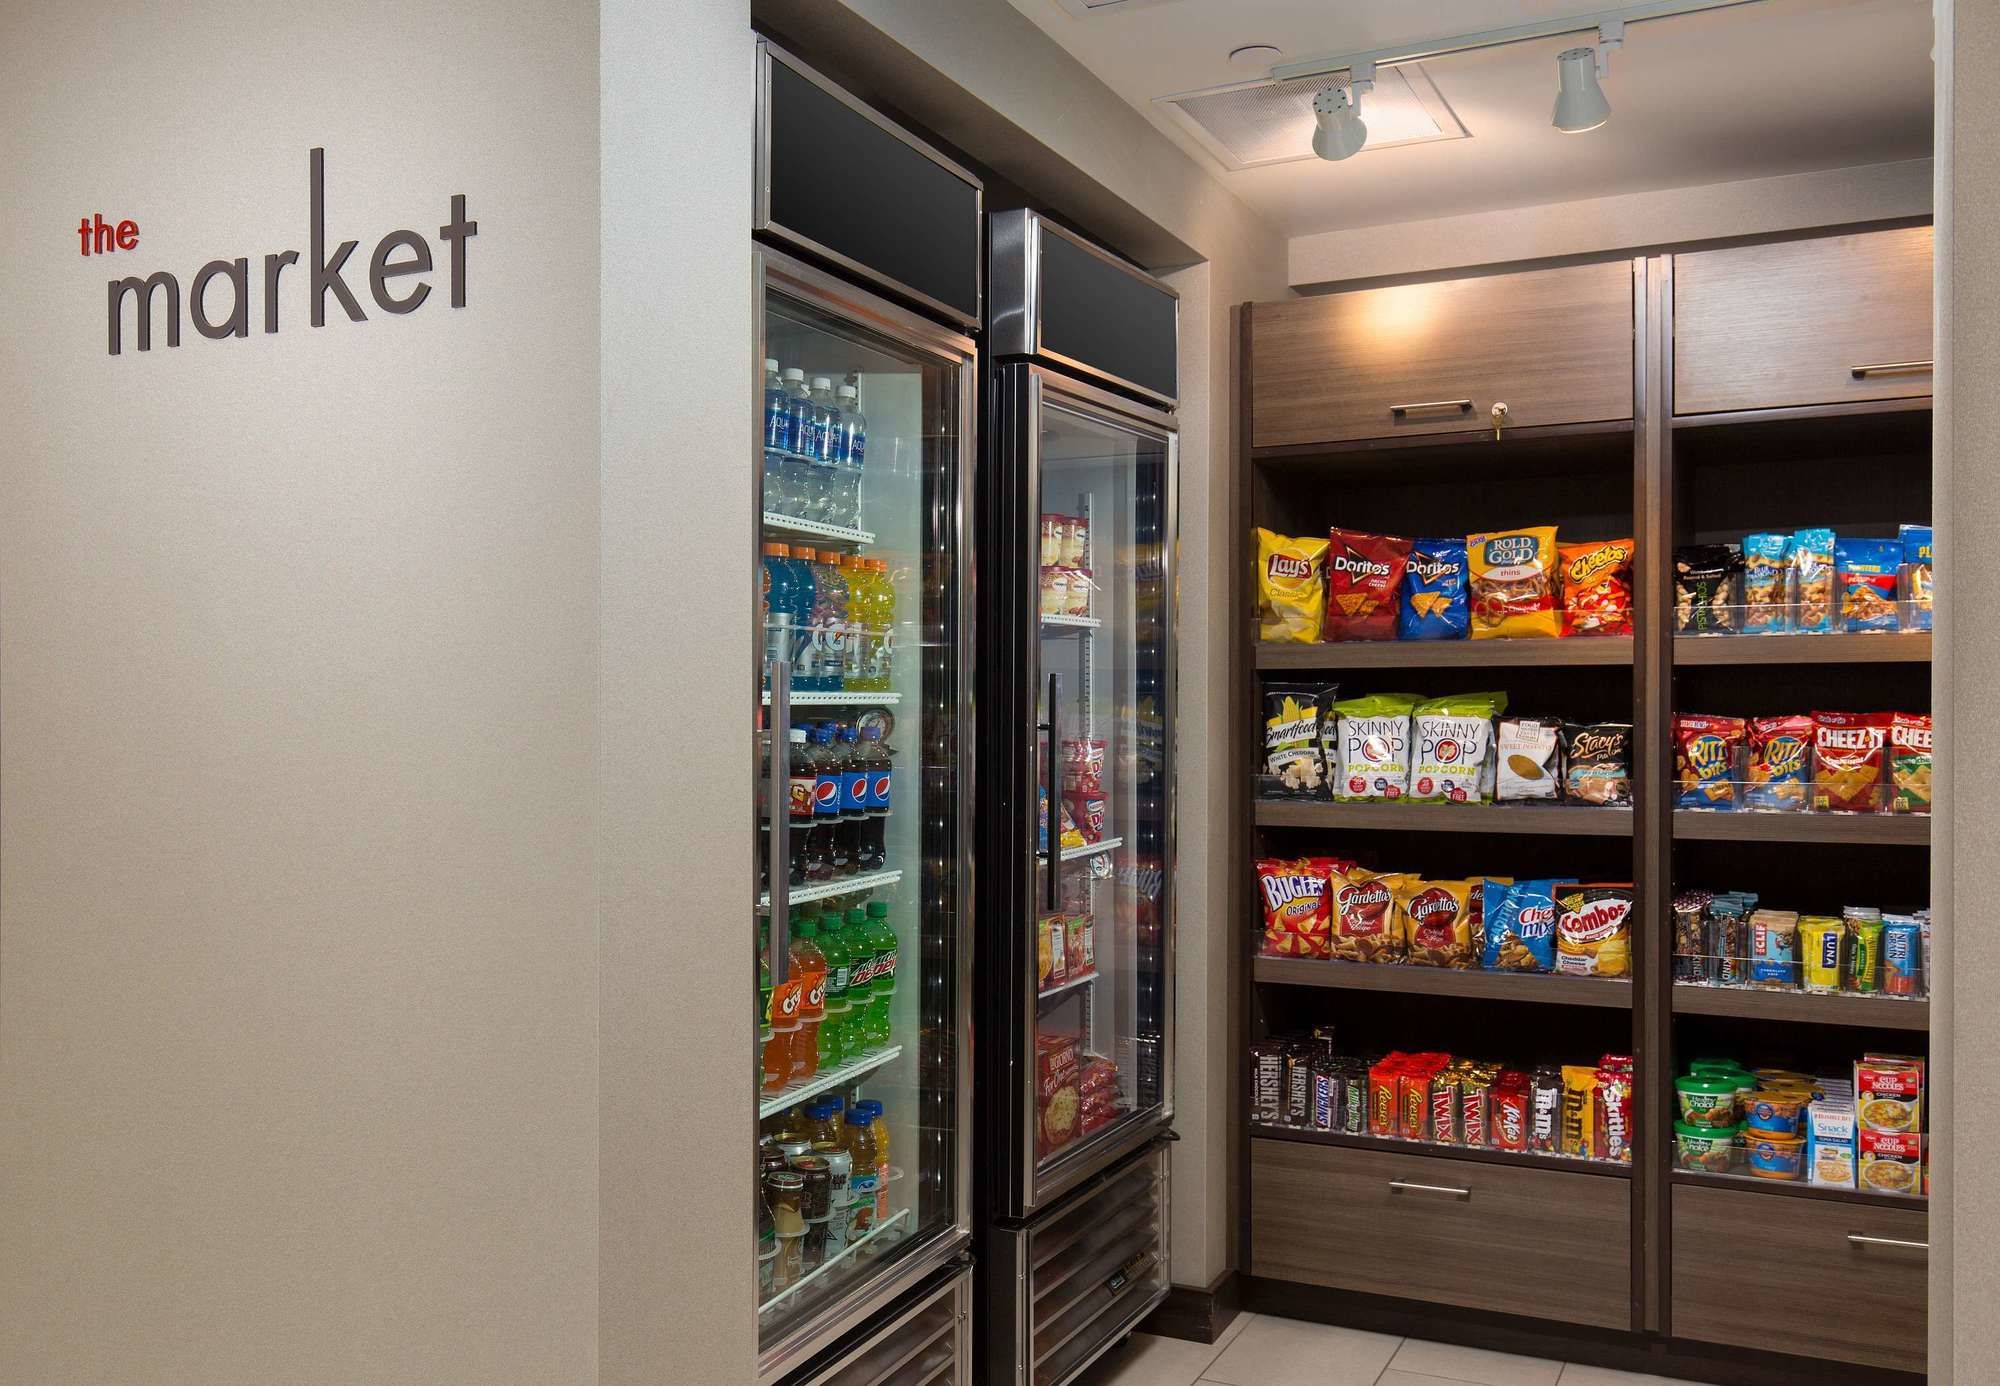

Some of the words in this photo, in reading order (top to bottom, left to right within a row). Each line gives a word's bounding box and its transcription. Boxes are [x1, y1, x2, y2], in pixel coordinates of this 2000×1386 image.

[77, 213, 140, 257] the
[107, 147, 478, 356] market
[1494, 537, 1532, 549] ROLD
[1335, 556, 1390, 576] Doritos
[1406, 561, 1459, 575] Doritos
[1488, 549, 1534, 565] GOLD
[1570, 545, 1626, 582] Cheetos
[1500, 568, 1521, 577] thins
[1348, 720, 1403, 736] SKINNY
[1421, 721, 1480, 738] SKINNY
[1421, 738, 1477, 765] POP
[1571, 733, 1624, 759] Stacy's
[1689, 740, 1728, 767] RITZ
[1764, 740, 1802, 765] RITZ
[1418, 765, 1476, 775] POPCORN
[1262, 875, 1326, 912] BUGLES
[1337, 885, 1392, 916] Gardetto's
[1562, 904, 1627, 933] Combos
[1756, 923, 1767, 948] CLIF
[1826, 936, 1835, 965] LUNA
[1721, 958, 1732, 980] KIND
[1260, 1055, 1280, 1120] HERSHEY'S
[1291, 1066, 1307, 1117] HERSHEY'S
[1379, 1085, 1392, 1127] Reese's
[1409, 1088, 1422, 1129] Reese's
[1432, 1086, 1454, 1140] TWIX
[1463, 1088, 1484, 1144] TWIX
[1818, 1122, 1848, 1133] Snack
